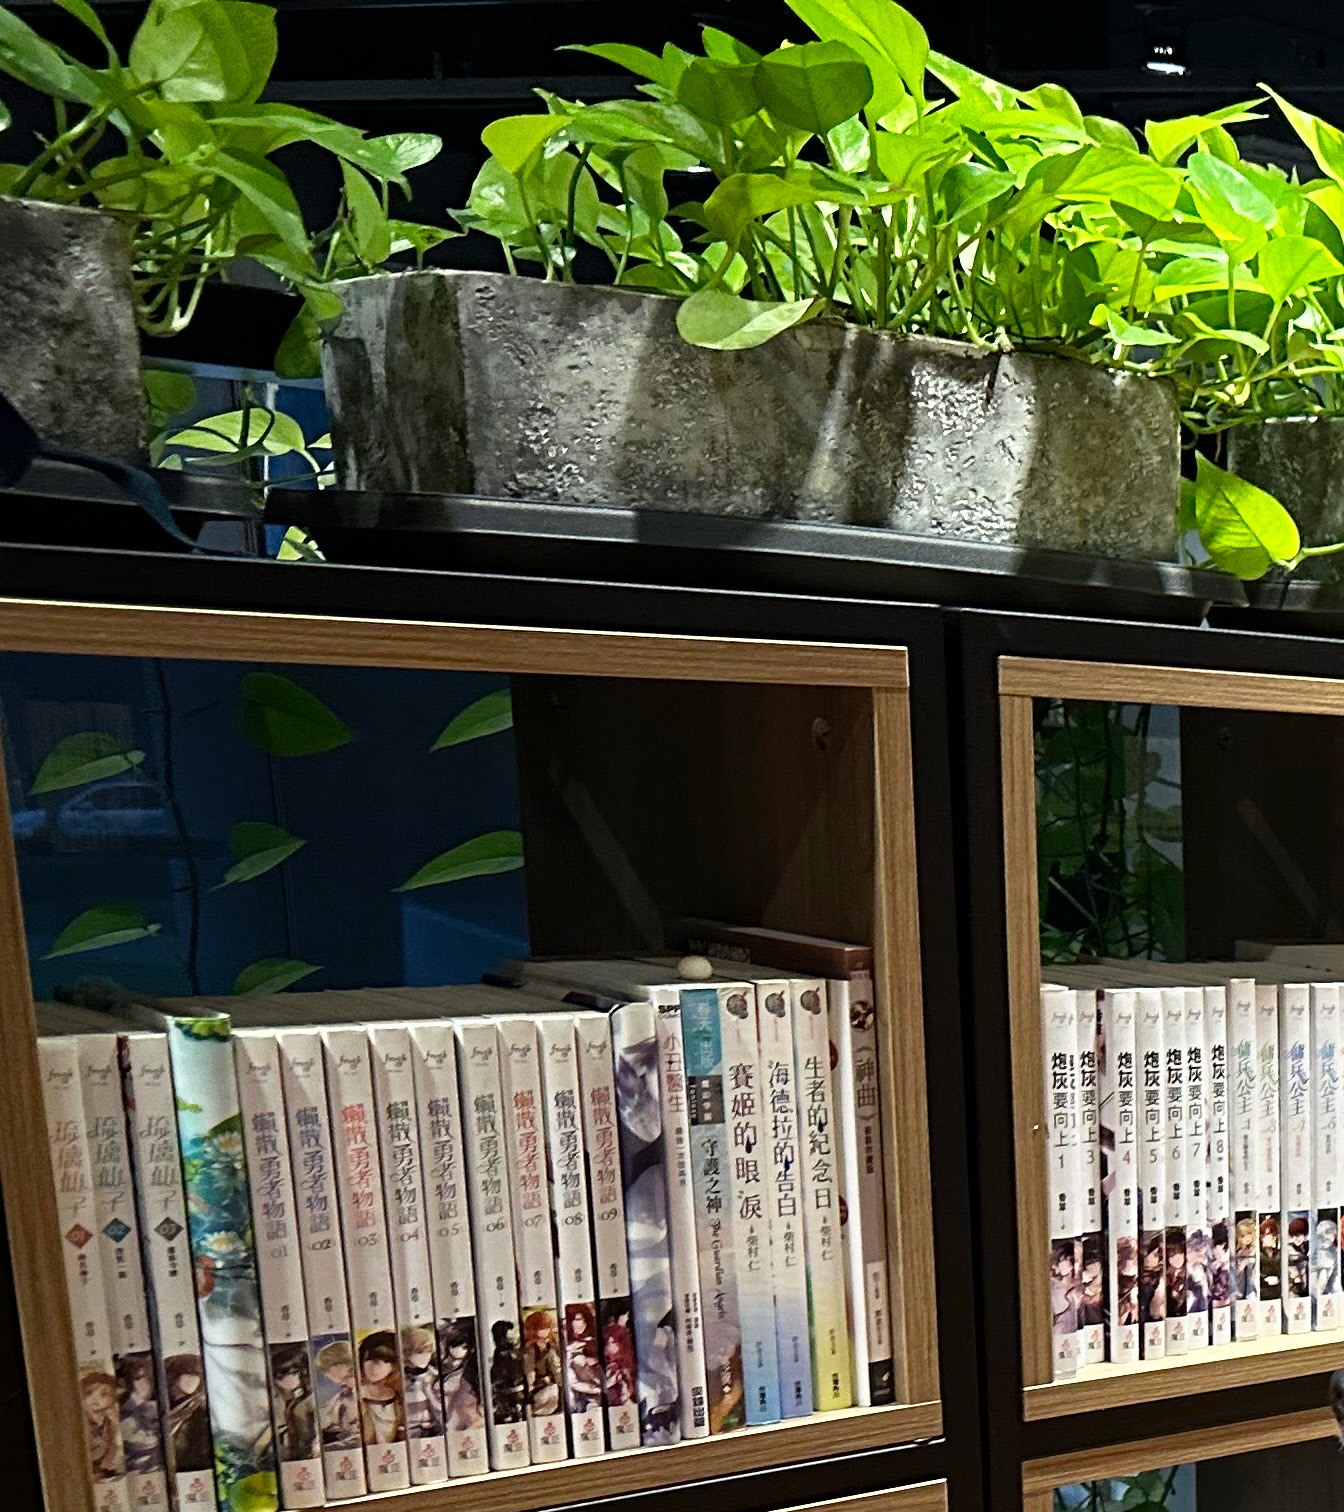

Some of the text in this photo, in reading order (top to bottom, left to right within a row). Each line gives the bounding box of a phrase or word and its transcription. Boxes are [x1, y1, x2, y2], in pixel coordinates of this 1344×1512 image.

[663, 1035, 685, 1113] 小丑醫生
[729, 1062, 763, 1220] 賽姬的眼淚
[767, 1059, 796, 1218] 海德拉的告白
[804, 1055, 833, 1210] 生者的紀念日
[1051, 1052, 1069, 1169] 炮灰要向上 1
[1080, 1050, 1098, 1165] 炮灰要向上 3
[1117, 1051, 1134, 1164] 炮灰要向上 4
[1143, 1051, 1161, 1164] 炮灰要向上 5
[1166, 1048, 1183, 1160] 炮灰要向上 6
[1187, 1047, 1203, 1157] 炮灰要向上 7
[1211, 1044, 1226, 1153] 炮灰要向上 8
[252, 1112, 289, 1259] 懶散勇者物語 01
[295, 1107, 331, 1250] 懶散勇者物語 02
[341, 1103, 378, 1246] 懶散勇者物語 03
[386, 1101, 419, 1242] 懶散勇者物語 04
[428, 1097, 459, 1238] 懶散勇者物語 05
[474, 1093, 504, 1232] 懶散勇者物語 06
[513, 1090, 543, 1228] 懶散勇者物語 07
[554, 1089, 582, 1226] 懶散勇者物語 08
[590, 1086, 617, 1221] 懶散勇者物語 09
[701, 1138, 722, 1214] 守護之神
